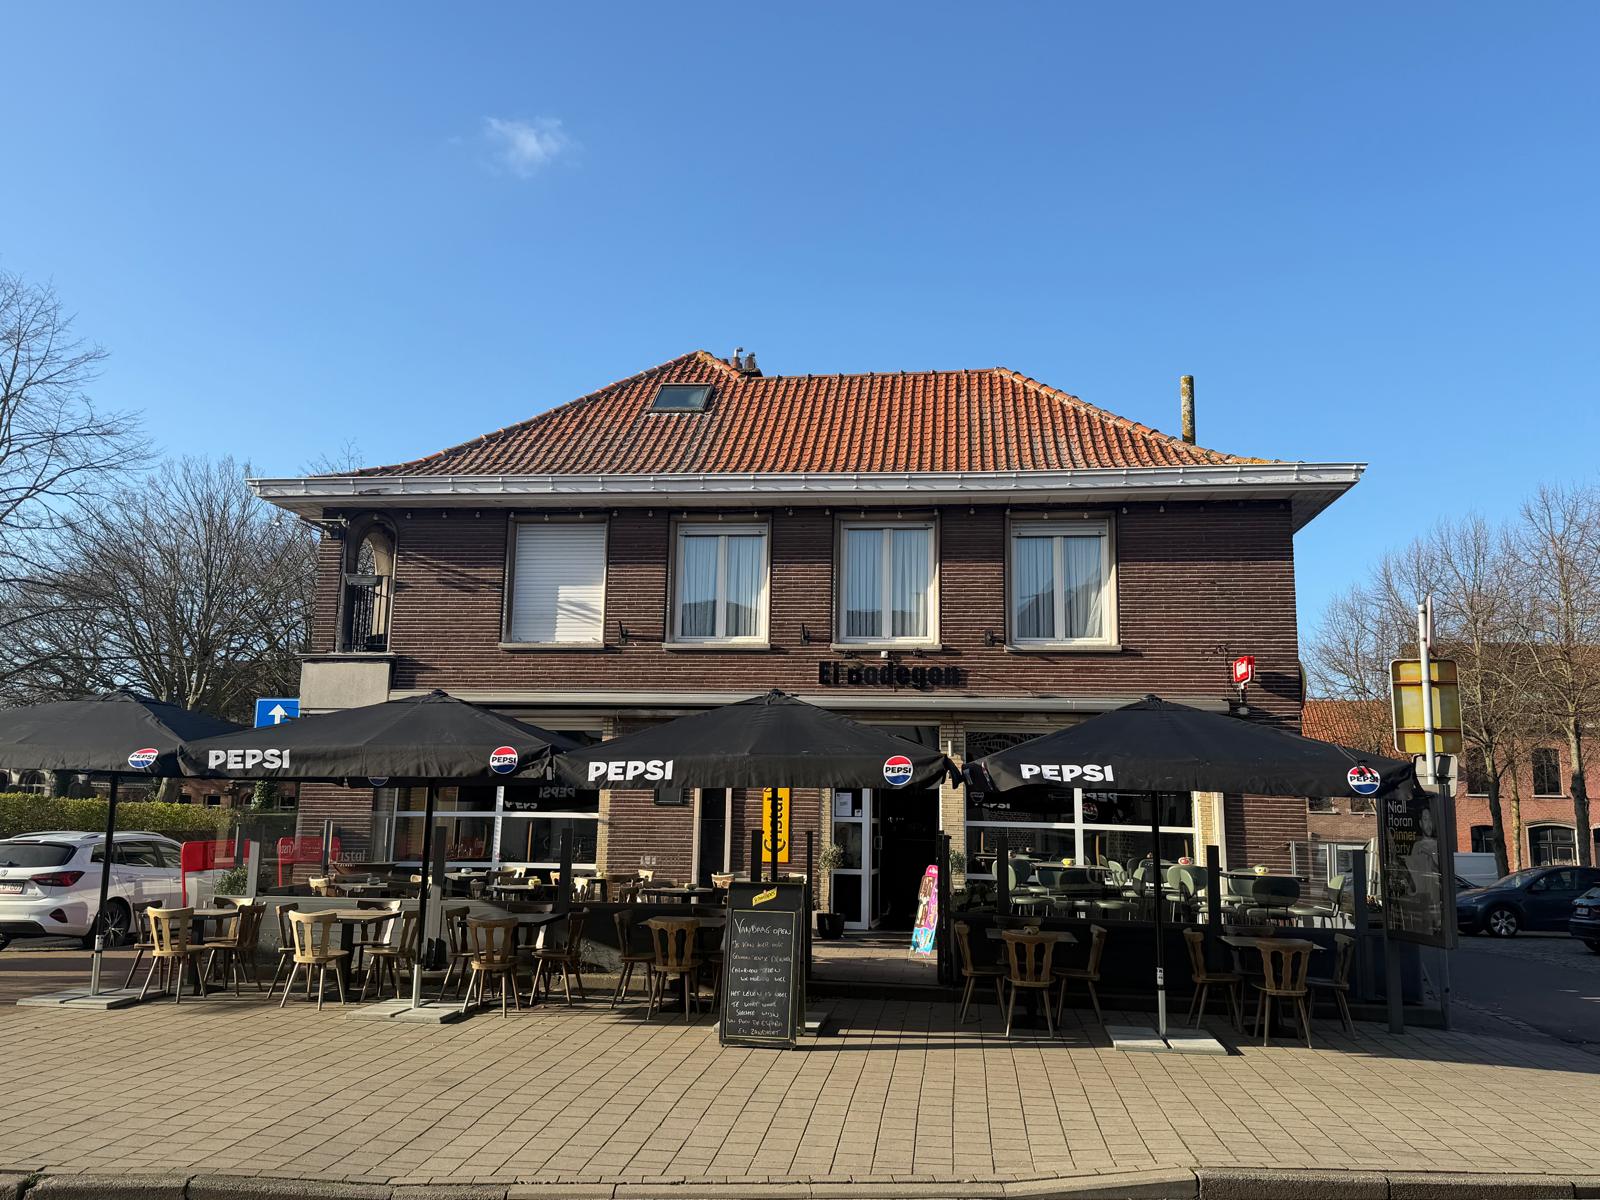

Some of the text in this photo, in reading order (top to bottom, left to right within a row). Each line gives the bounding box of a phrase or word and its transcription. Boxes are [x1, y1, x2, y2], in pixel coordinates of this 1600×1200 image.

[208, 749, 290, 769] PEPSI
[491, 756, 517, 764] PEPSI
[588, 760, 674, 782] PEPSI
[885, 766, 912, 774] PEPSI
[1020, 764, 1115, 782] PEPSI
[1349, 775, 1379, 783] PEPSI
[1387, 800, 1407, 814] Niall
[1388, 813, 1414, 827] Horan
